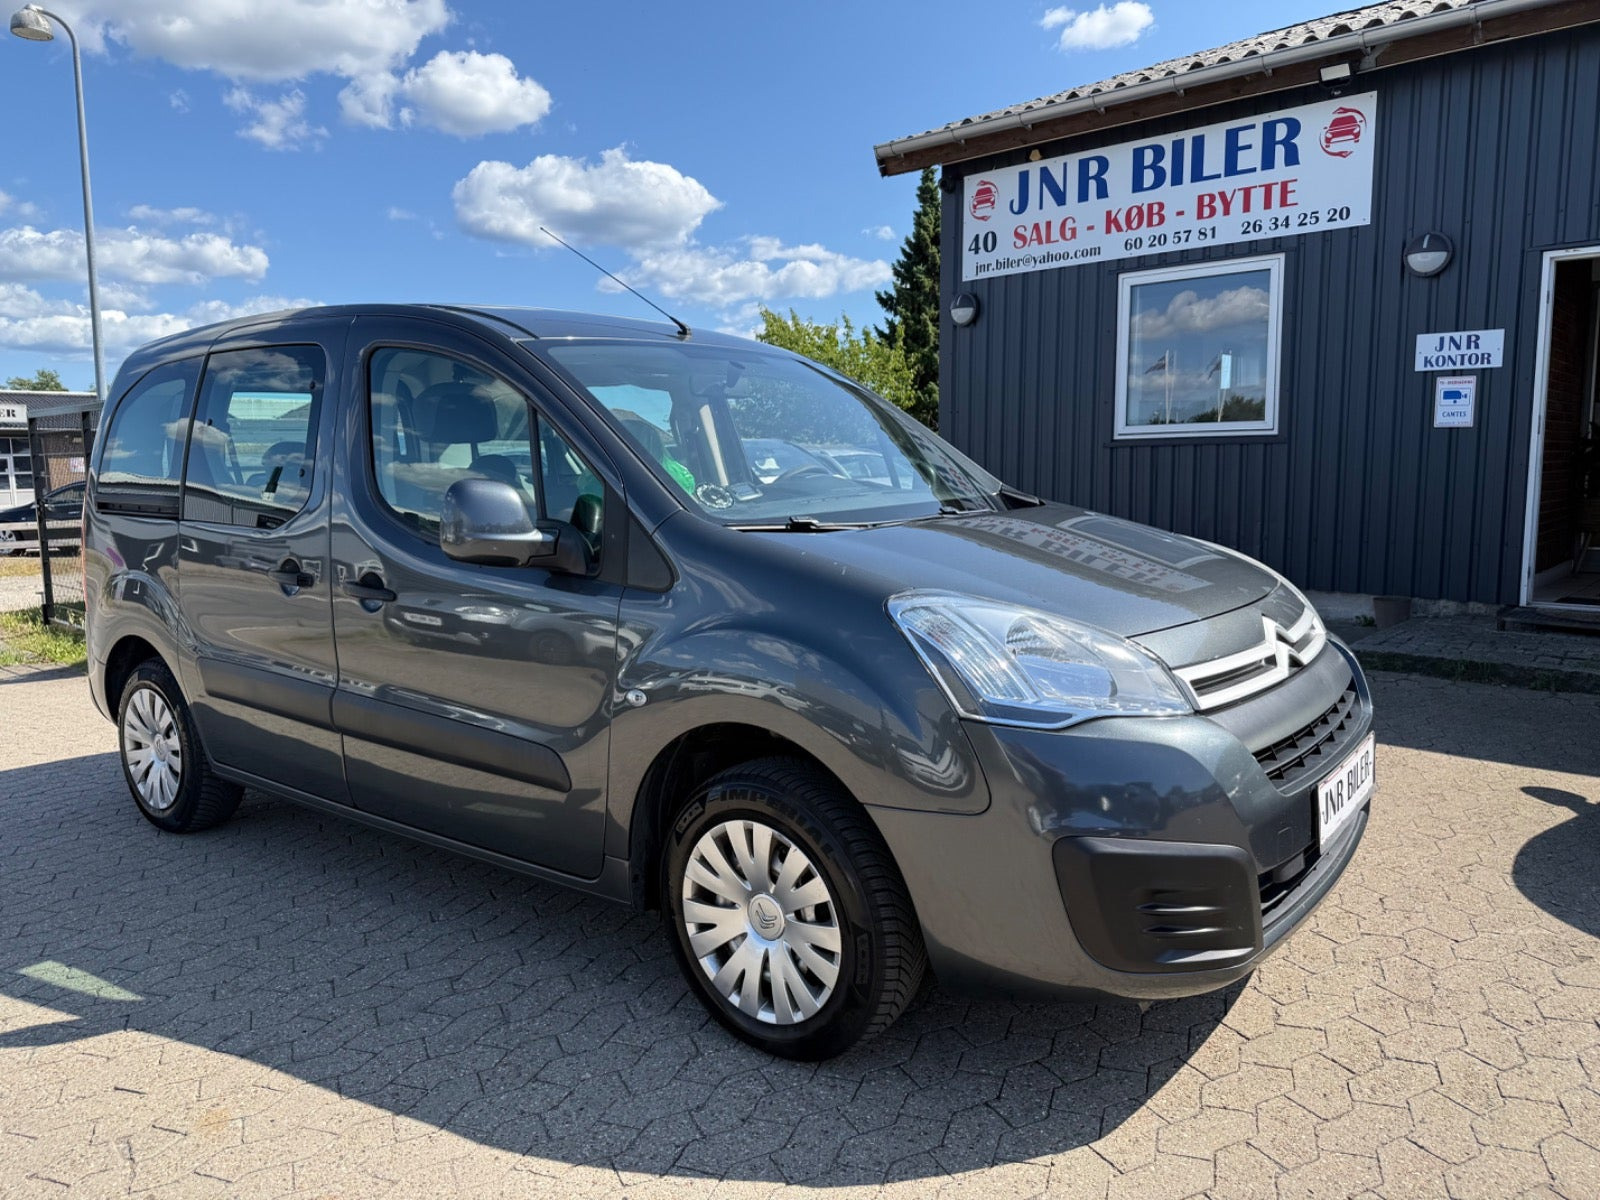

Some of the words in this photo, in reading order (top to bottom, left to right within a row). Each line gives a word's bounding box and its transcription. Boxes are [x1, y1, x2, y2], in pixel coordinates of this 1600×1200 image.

[1009, 155, 1109, 215] JNR
[1132, 117, 1302, 194] BILER
[1013, 216, 1078, 249] SALG
[1105, 202, 1166, 235] KØB
[1196, 178, 1299, 221] BYTTE
[1241, 219, 1263, 235] 26
[1268, 214, 1291, 231] 34
[1297, 210, 1320, 227] 25
[1327, 206, 1351, 223] 20
[968, 231, 997, 255] 40
[1124, 236, 1143, 251] 60
[1148, 233, 1167, 247] 20
[1172, 229, 1192, 244] 57
[1197, 226, 1217, 240] 81
[975, 246, 1101, 276] jnr.biler@yahoo.com
[1435, 334, 1480, 352] JNR
[1423, 352, 1492, 368] KONTOR
[1322, 779, 1344, 825] JNR
